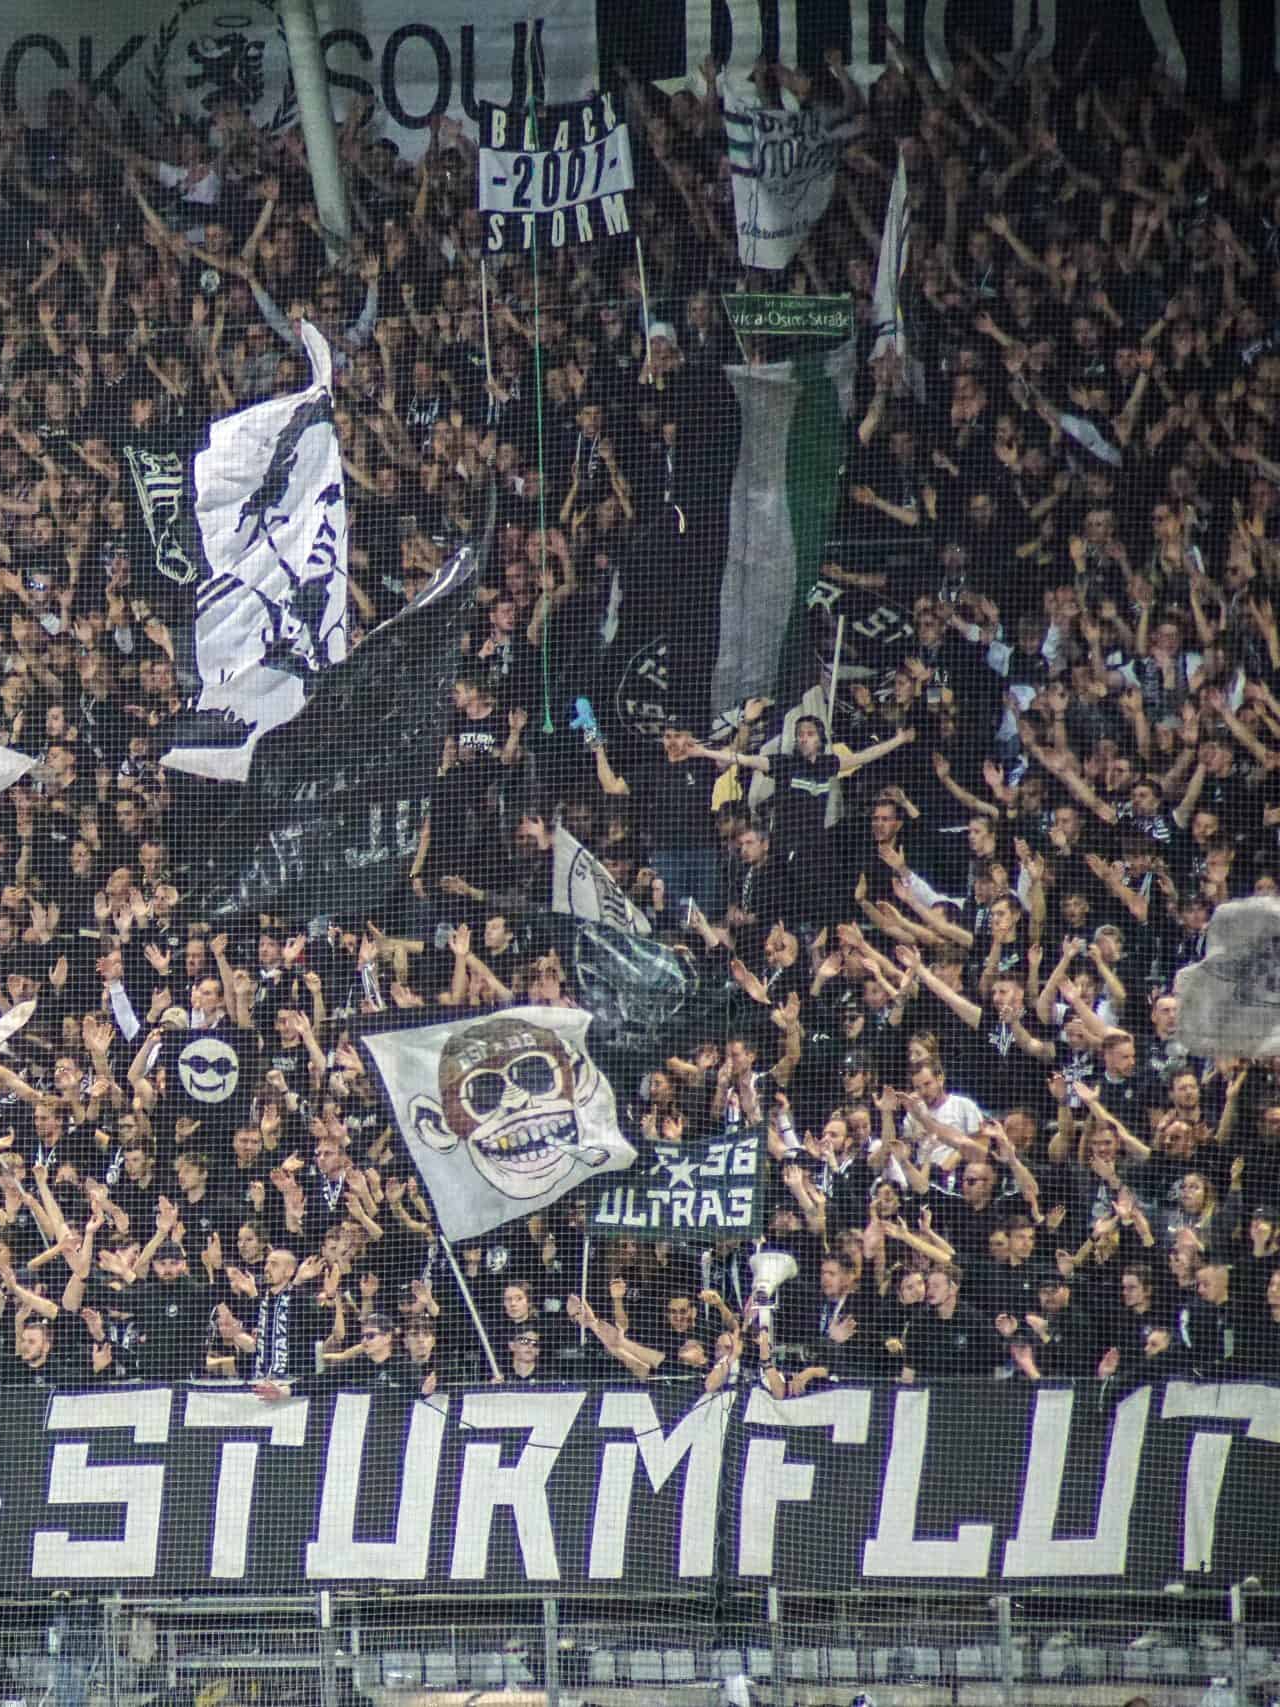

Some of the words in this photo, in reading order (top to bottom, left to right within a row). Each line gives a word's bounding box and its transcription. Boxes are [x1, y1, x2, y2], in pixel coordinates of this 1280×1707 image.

[490, 92, 617, 152] BLACK
[487, 193, 630, 250] STORM
[595, 1187, 753, 1227] ULTRAS
[32, 1381, 1280, 1580] STURMFLUT
